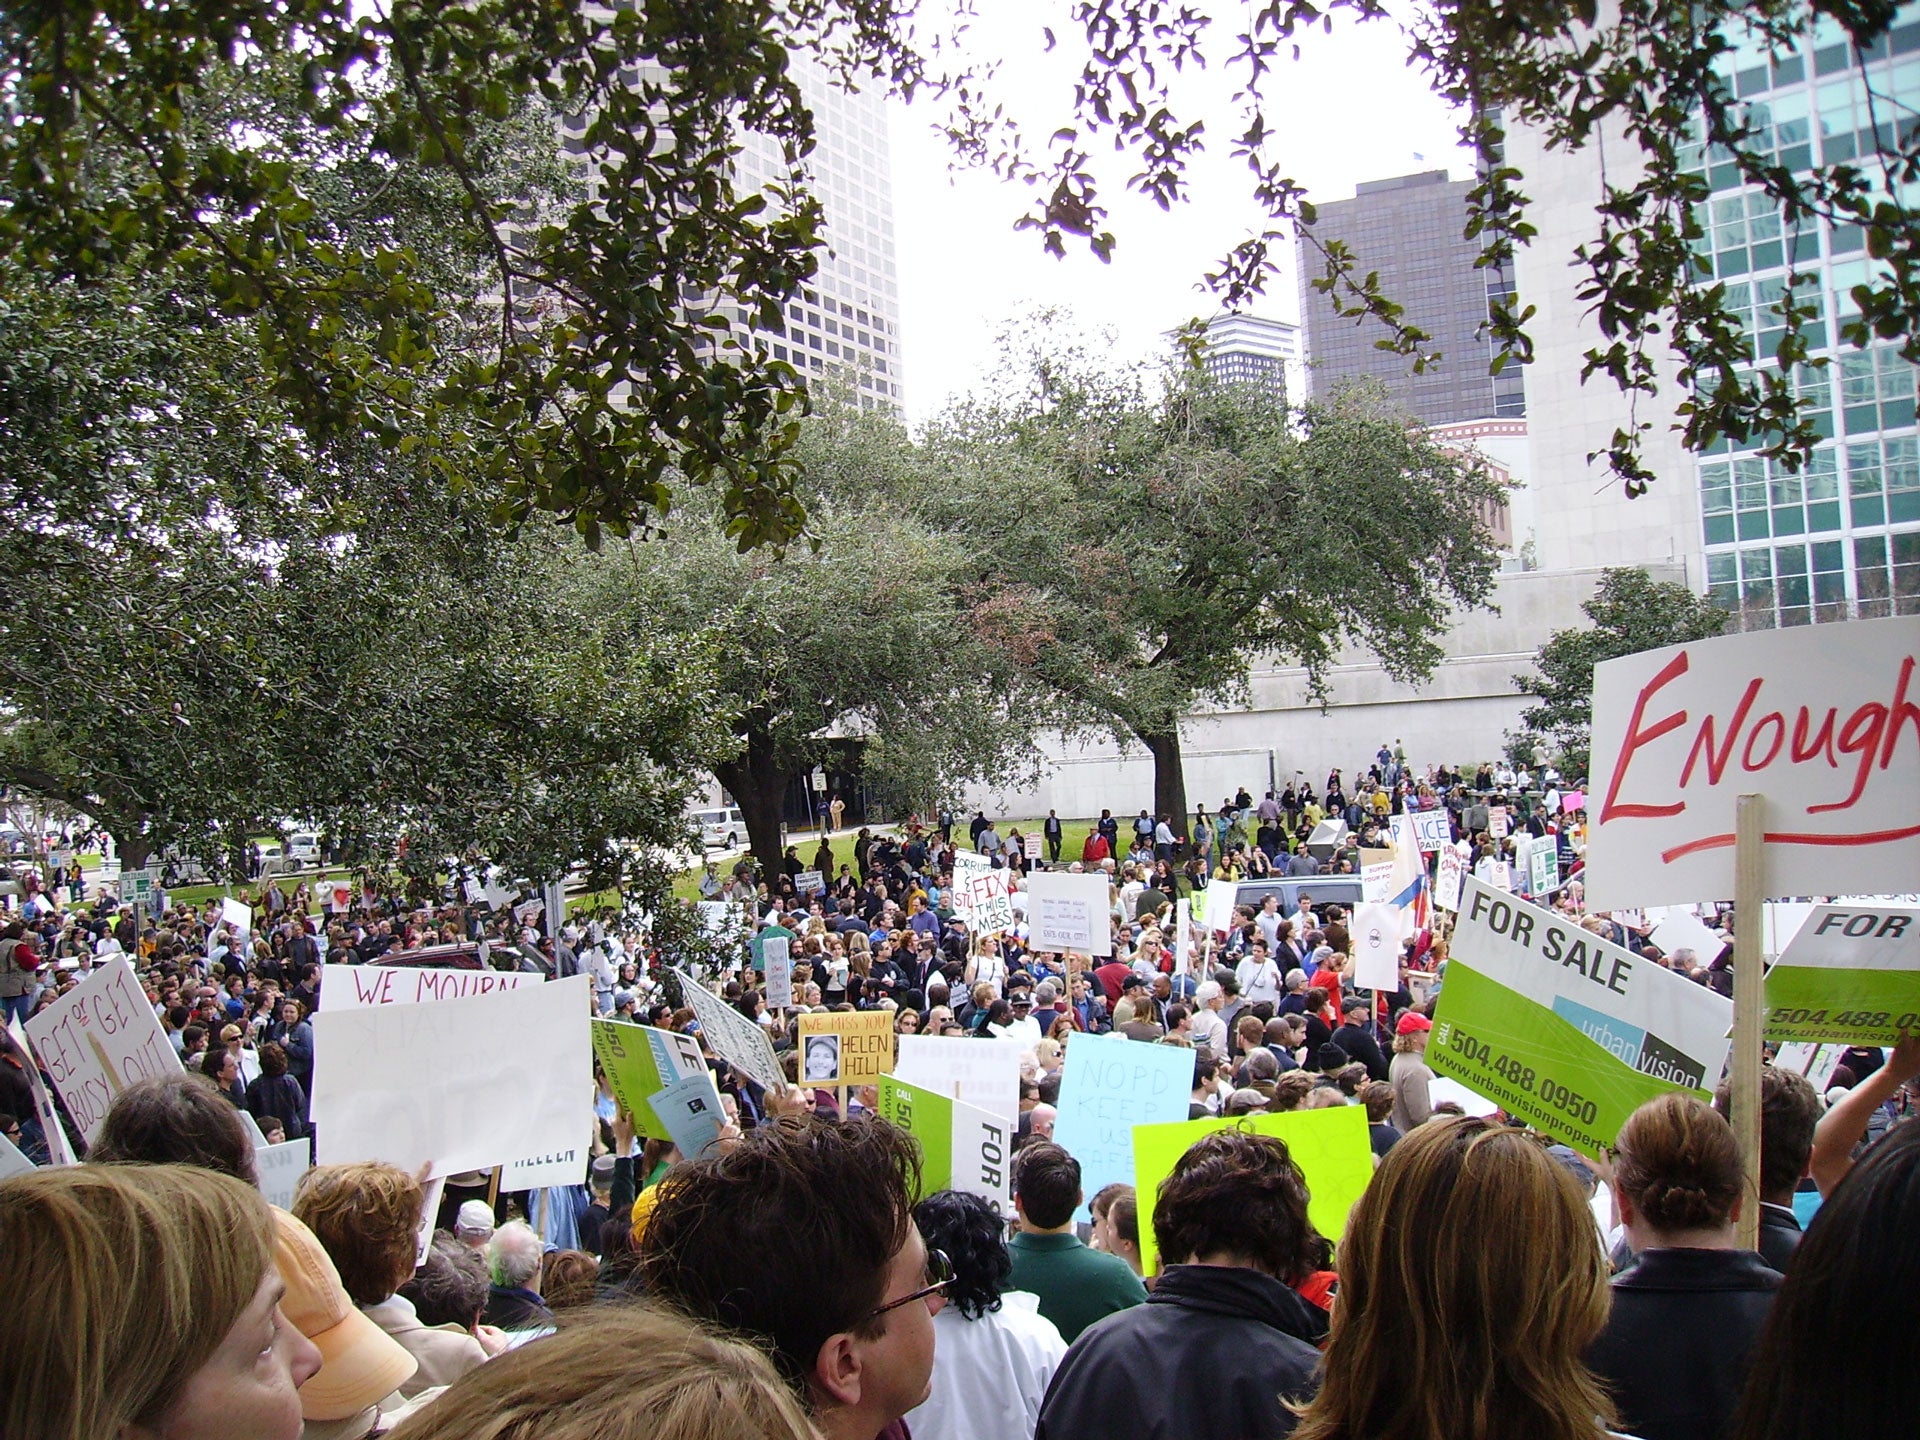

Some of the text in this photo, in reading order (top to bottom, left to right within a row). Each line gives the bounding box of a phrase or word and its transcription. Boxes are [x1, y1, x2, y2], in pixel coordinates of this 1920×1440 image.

[1600, 650, 1920, 825] Enough
[1391, 819, 1450, 843] PLICE
[1420, 840, 1441, 850] PAID
[973, 871, 1007, 902] FIX
[955, 892, 973, 909] STU
[975, 897, 1007, 915] THIS
[978, 909, 1012, 934] MESS
[1813, 912, 1912, 938] FOR
[1470, 890, 1633, 996] FOR SALE
[353, 969, 398, 1005] WE
[40, 970, 140, 1083] GET or GET
[804, 1015, 886, 1031] WE MISS YOU
[1437, 1022, 1450, 1046] CALL
[841, 1034, 888, 1054] HELEN
[1582, 1019, 1699, 1091] urban vision
[1081, 1060, 1169, 1096] NOPD
[1451, 1028, 1599, 1126] 504.488.0950
[66, 1072, 114, 1133] BUSY
[896, 1088, 913, 1102] CALL
[1078, 1096, 1159, 1122] KEEP
[1100, 1128, 1130, 1147] US
[981, 1122, 1003, 1189] FOR
[1076, 1148, 1135, 1173] SAFE
